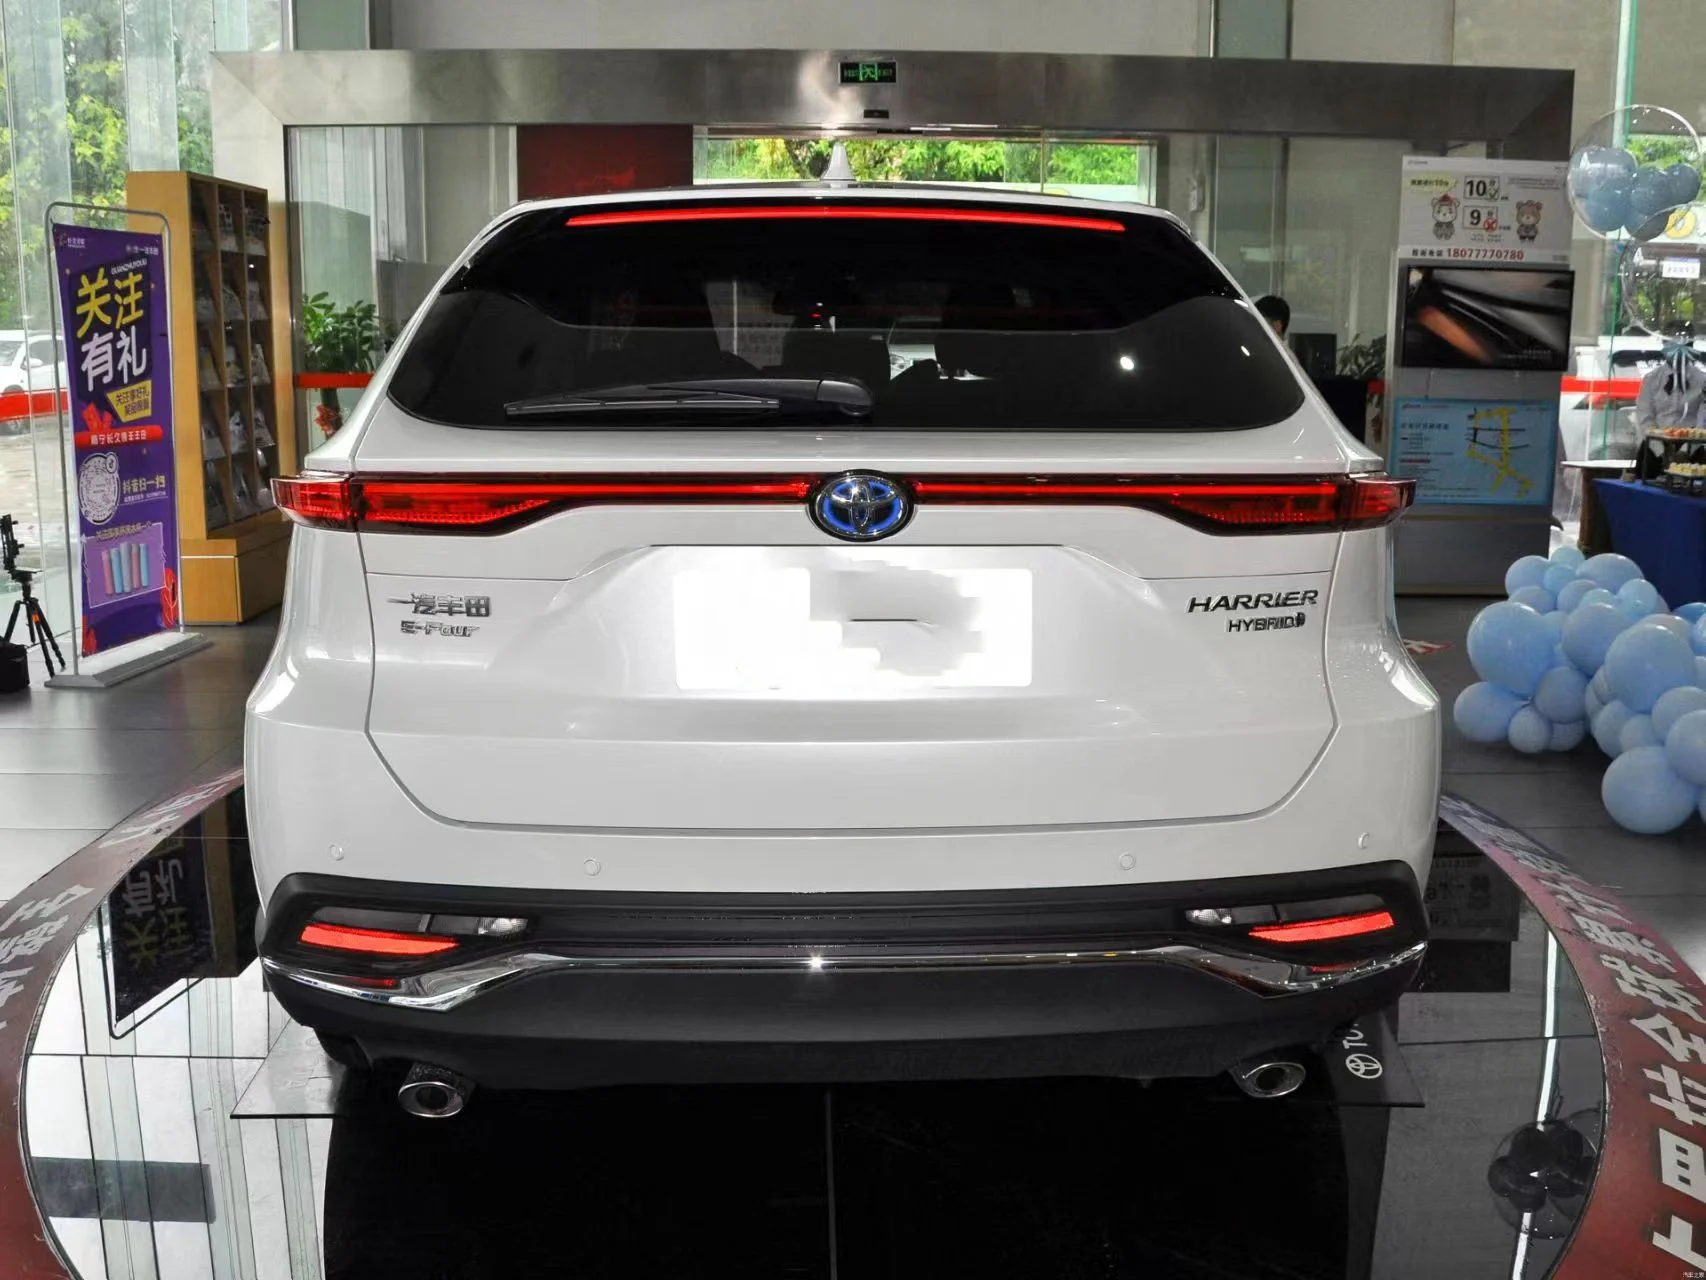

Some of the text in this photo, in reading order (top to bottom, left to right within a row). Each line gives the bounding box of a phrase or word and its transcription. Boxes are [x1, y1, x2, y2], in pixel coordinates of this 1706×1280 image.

[76, 267, 144, 339] 关注
[80, 325, 147, 392] 有礼
[1186, 590, 1318, 613] HARRIER
[1228, 615, 1295, 632] HYBRID
